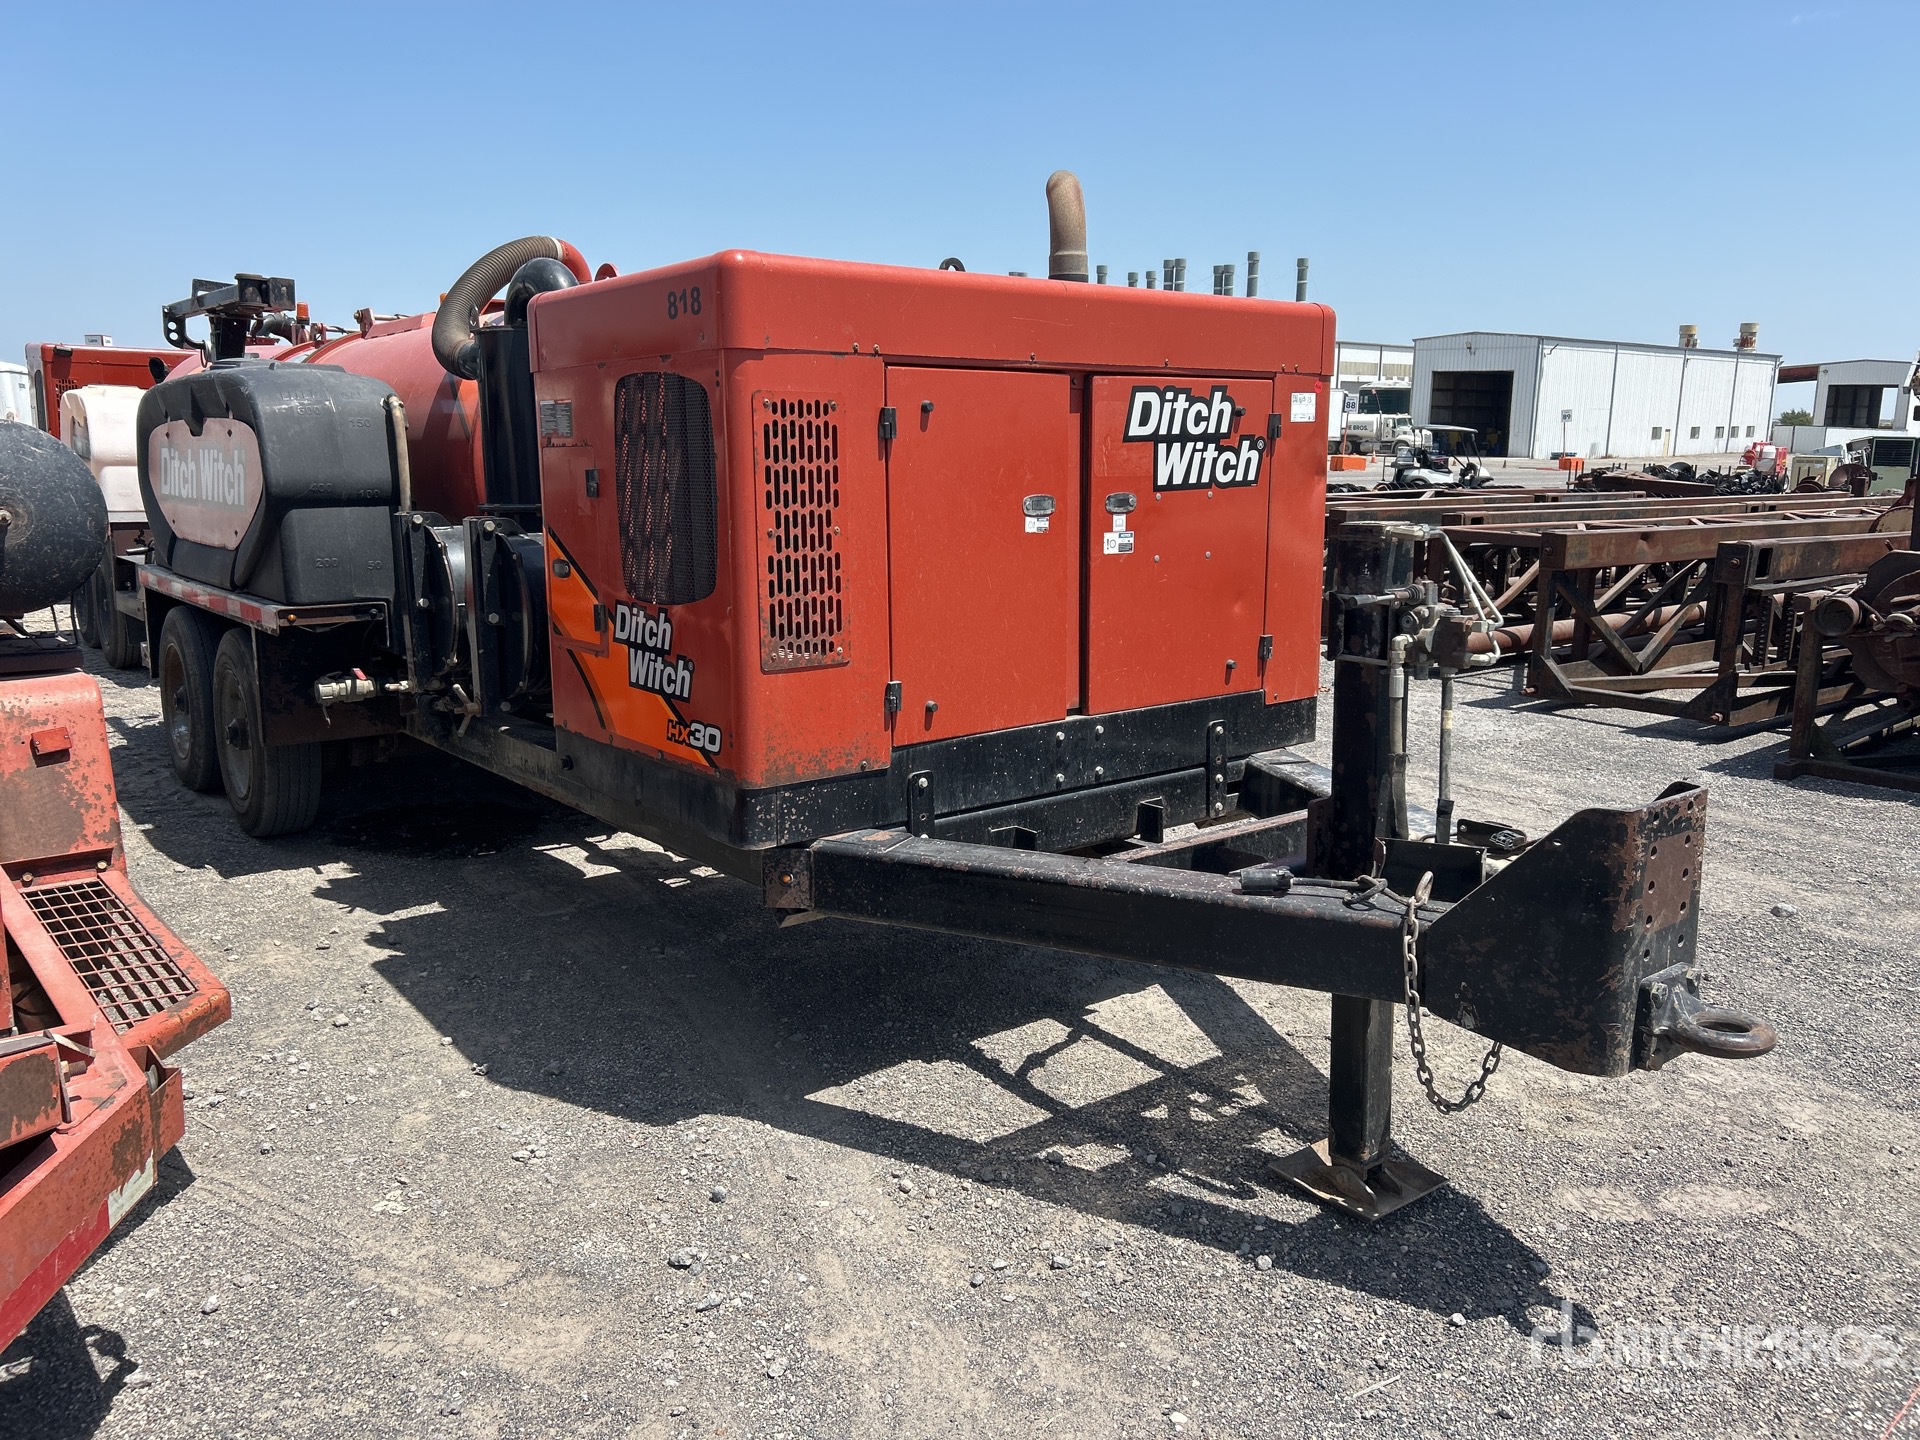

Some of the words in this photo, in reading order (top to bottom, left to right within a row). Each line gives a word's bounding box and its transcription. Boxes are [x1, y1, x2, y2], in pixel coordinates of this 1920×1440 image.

[667, 286, 702, 320] 818
[296, 405, 321, 416] 600
[1128, 391, 1233, 437] Ditch
[1345, 401, 1356, 409] 88
[348, 417, 372, 428] 150
[160, 447, 197, 499] Ditch
[199, 448, 245, 506] Witch
[1157, 440, 1260, 486] Witch
[309, 482, 333, 493] 400
[358, 489, 380, 499] 100
[315, 557, 338, 569] 200
[367, 560, 382, 571] 50
[615, 604, 672, 651] Ditch
[629, 647, 691, 699] Witch
[666, 721, 722, 754] HX30
